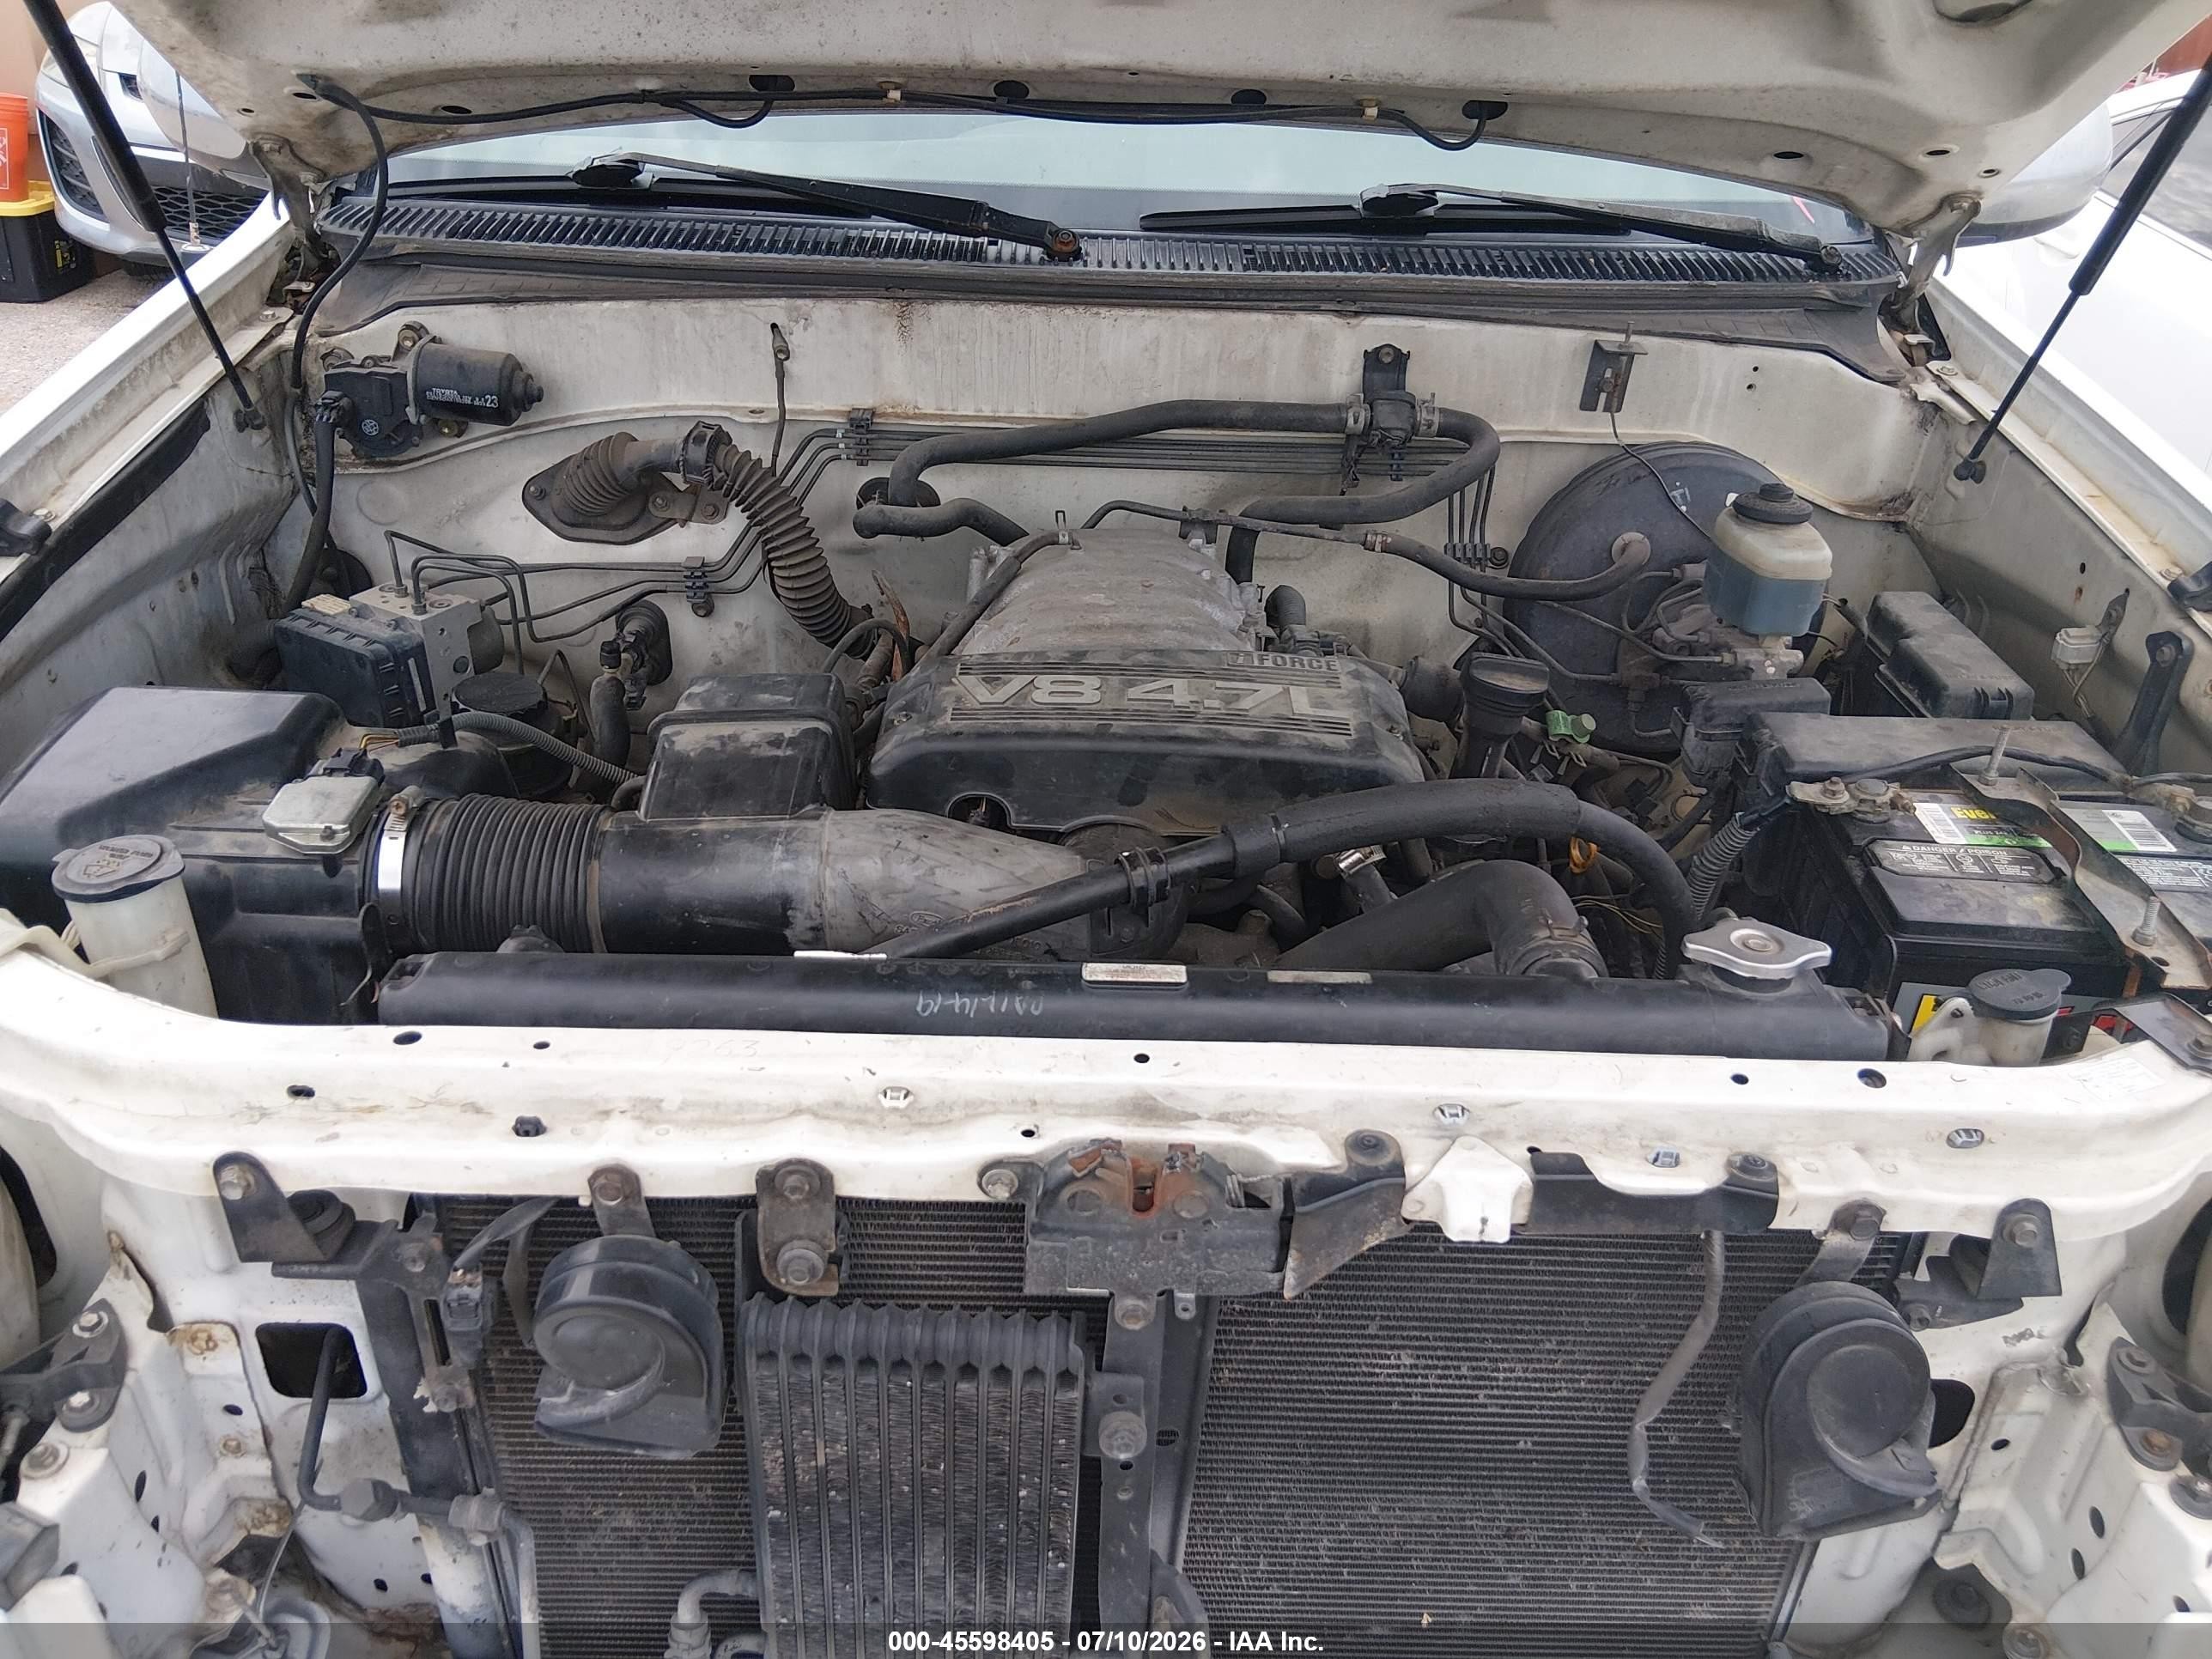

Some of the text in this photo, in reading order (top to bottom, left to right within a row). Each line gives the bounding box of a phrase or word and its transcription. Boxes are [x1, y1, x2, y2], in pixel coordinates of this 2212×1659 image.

[484, 394, 499, 408] 23
[955, 674, 1352, 720] V8 4.7L
[1911, 845, 1957, 854] DANGER
[1966, 848, 2007, 856] POISON
